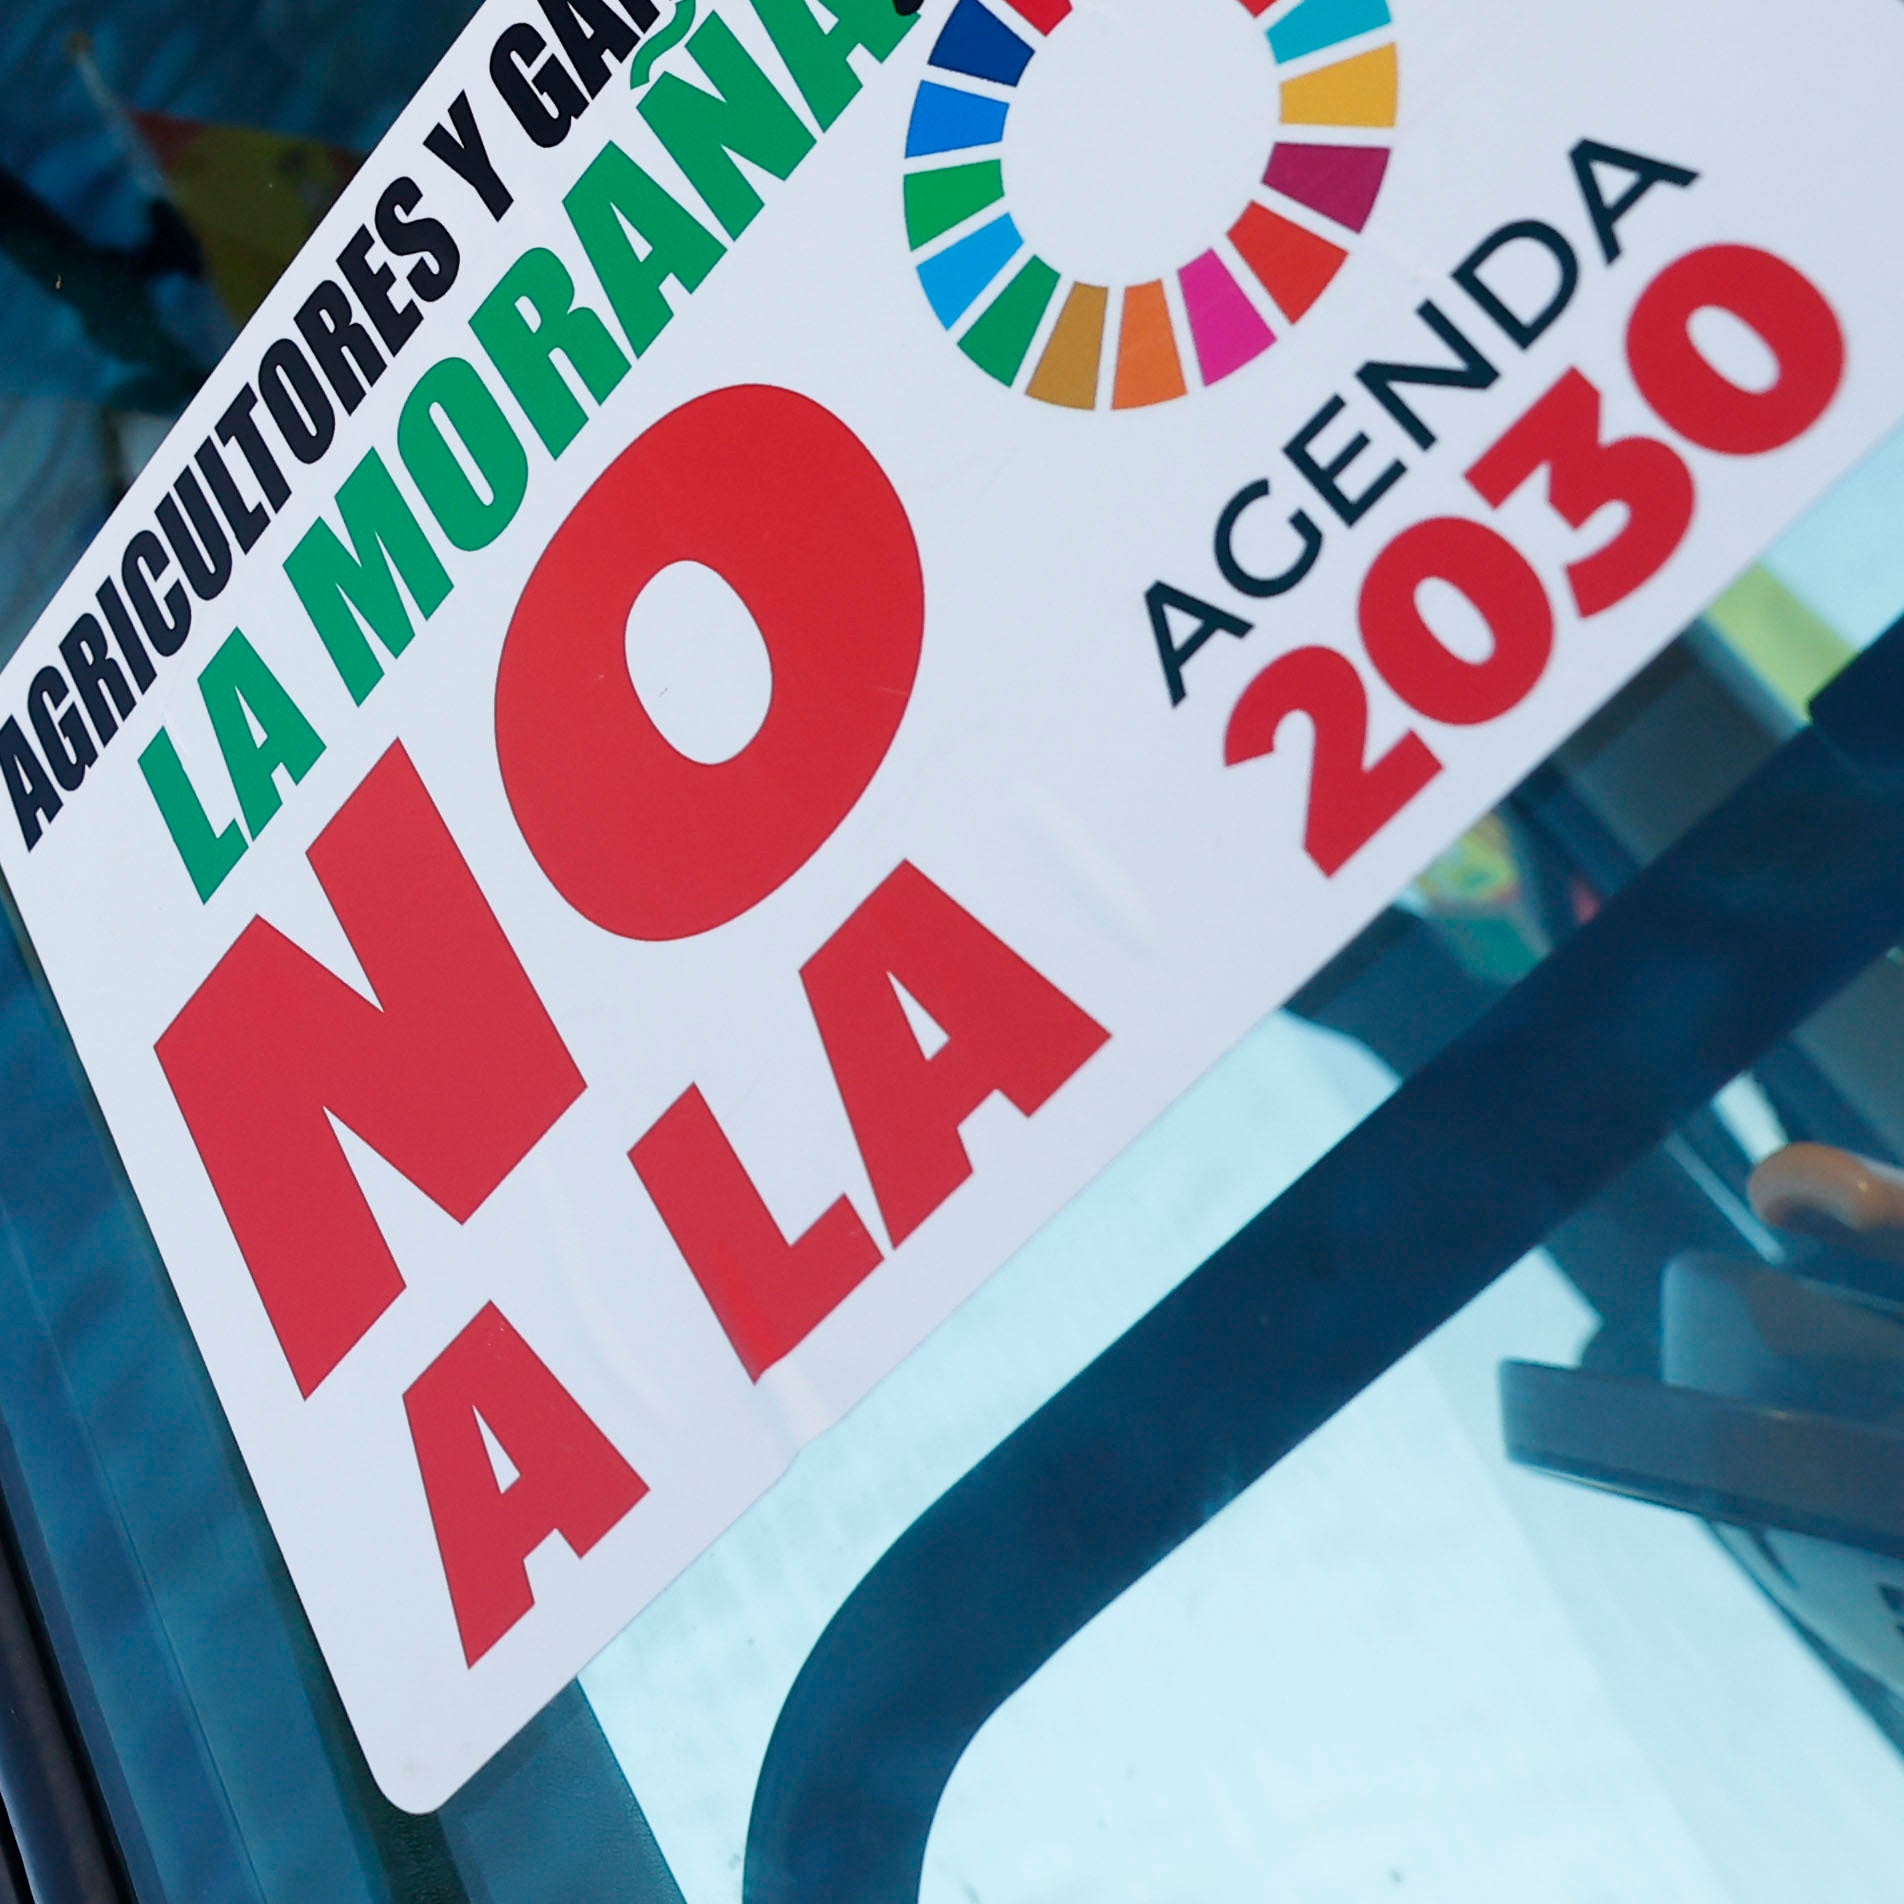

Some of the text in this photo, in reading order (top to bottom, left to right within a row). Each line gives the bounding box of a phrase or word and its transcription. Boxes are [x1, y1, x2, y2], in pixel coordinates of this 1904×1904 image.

[421, 88, 515, 223] Y
[1144, 138, 1699, 707] AGENDA
[136, 626, 328, 904] LA
[1224, 244, 1845, 878] 2030
[153, 382, 926, 1400] NO
[402, 859, 1112, 1669] A LA
